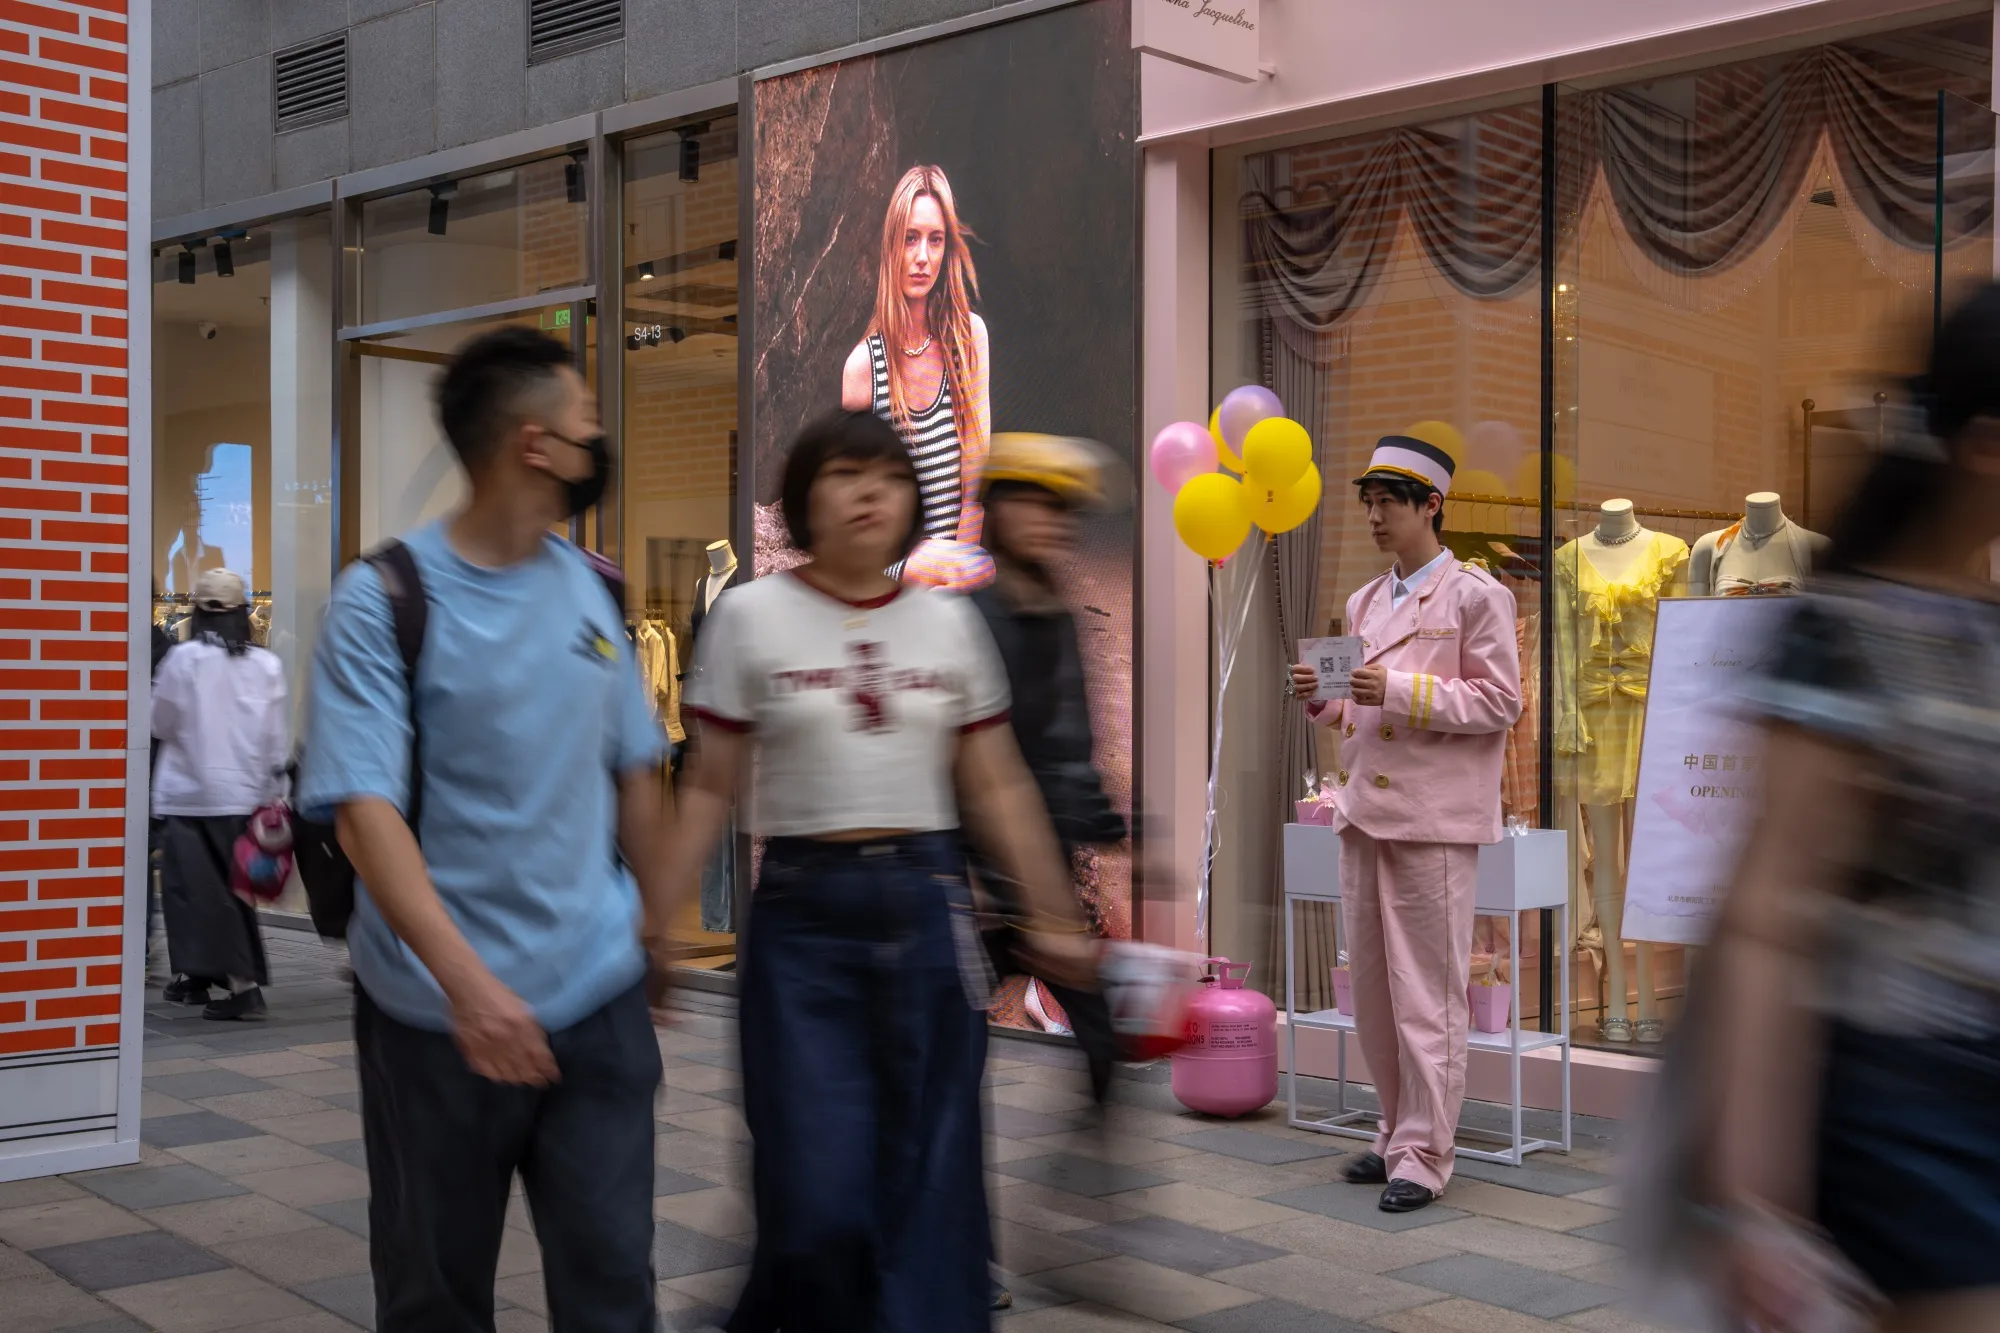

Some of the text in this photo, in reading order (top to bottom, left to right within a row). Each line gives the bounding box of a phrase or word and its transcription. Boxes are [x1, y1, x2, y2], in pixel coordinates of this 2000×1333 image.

[1193, 0, 1255, 31] Jacqueline
[634, 324, 661, 341] S4-13
[1683, 753, 1758, 772] 中国首家
